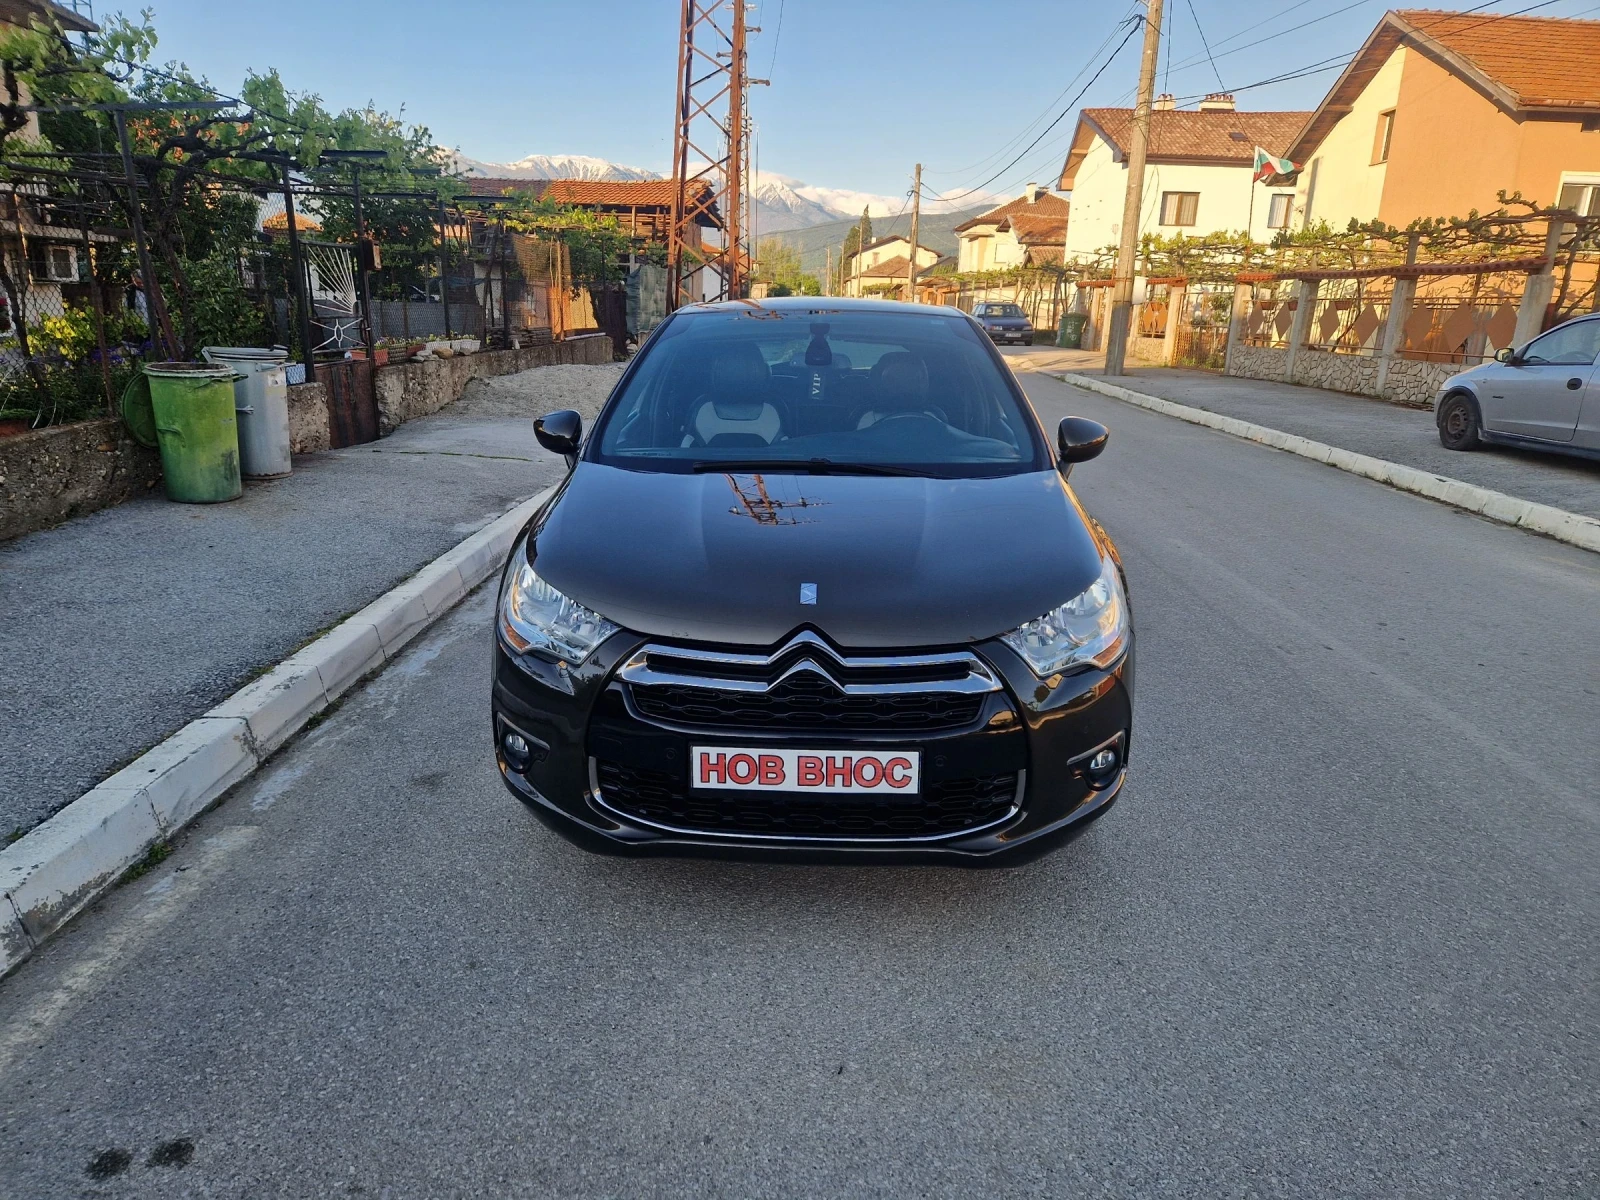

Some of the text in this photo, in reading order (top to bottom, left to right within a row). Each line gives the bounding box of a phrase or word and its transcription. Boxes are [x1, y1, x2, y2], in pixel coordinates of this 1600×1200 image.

[812, 373, 821, 395] VIP
[700, 753, 913, 789] НОВ ВНОС
